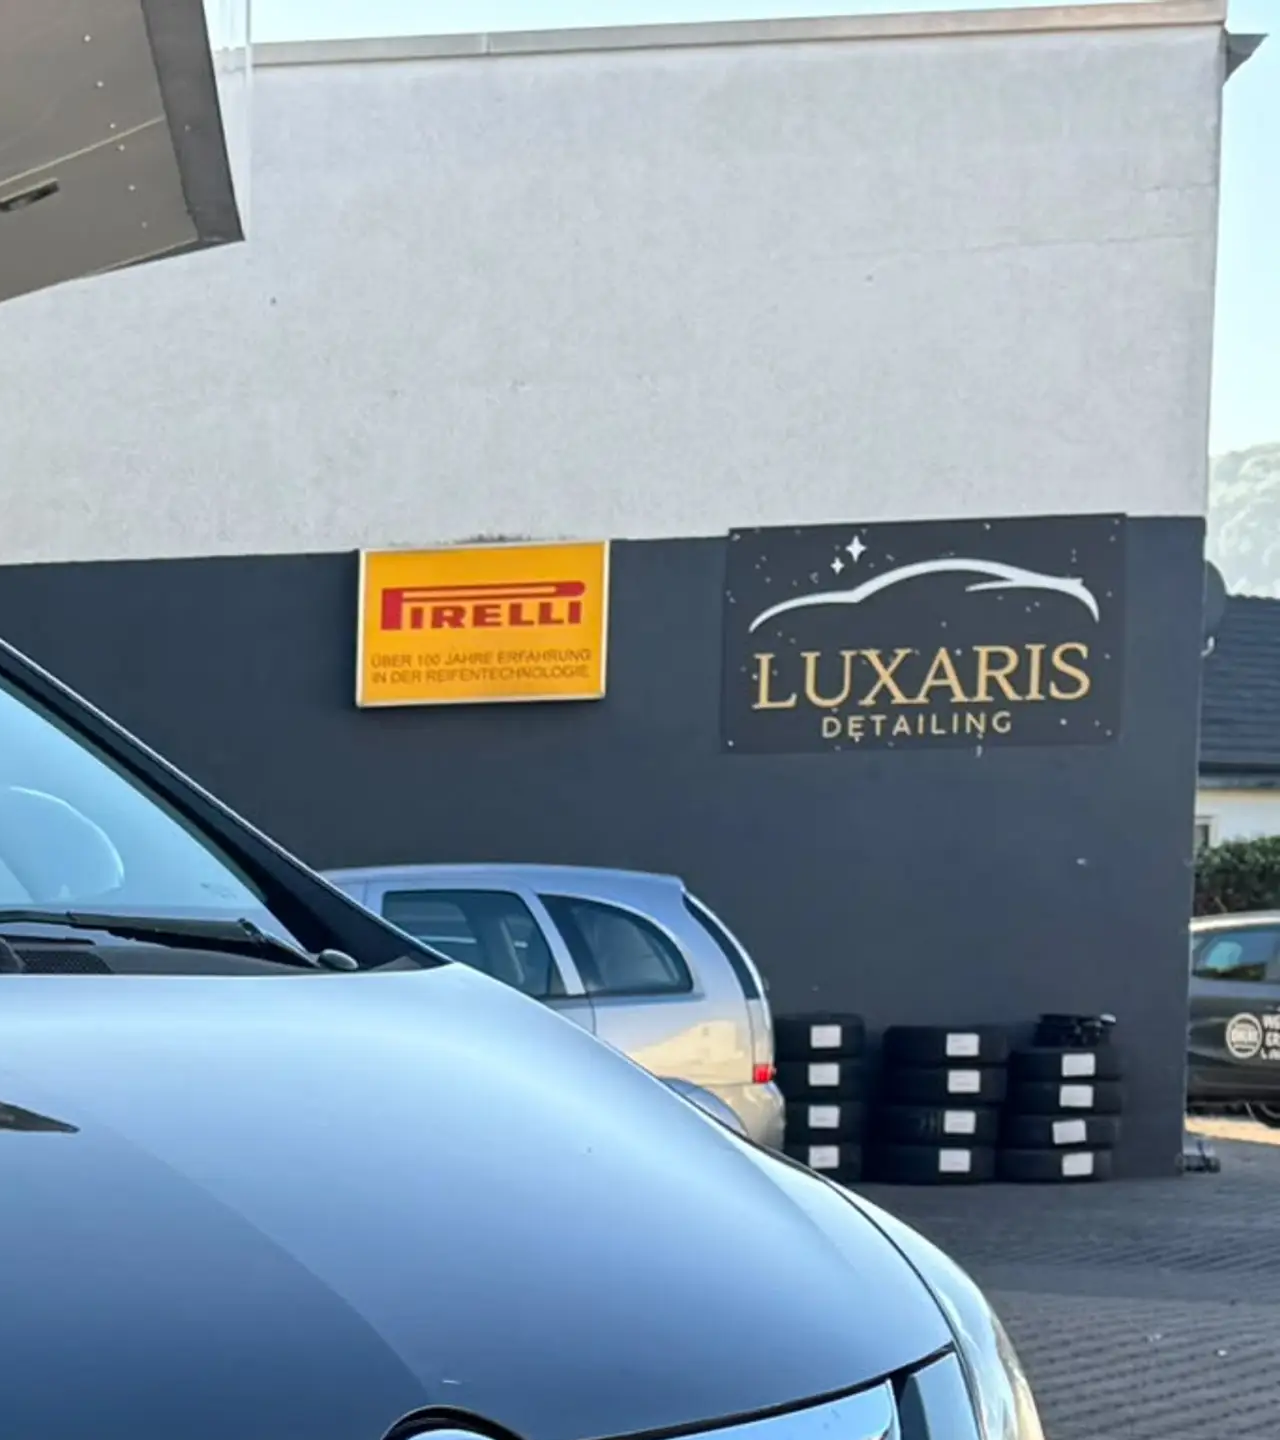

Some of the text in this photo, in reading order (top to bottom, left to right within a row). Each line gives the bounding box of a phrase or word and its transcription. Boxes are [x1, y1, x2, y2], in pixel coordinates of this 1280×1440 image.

[381, 580, 586, 631] PIRELLI
[417, 652, 441, 668] 100
[444, 650, 492, 667] JAHRE
[497, 648, 592, 665] ERFAHRUNG
[371, 664, 590, 684] IN DER REIFENTECHNOLOGIE
[752, 642, 1090, 709] LUXARIS
[821, 711, 1012, 739] DETAILING
